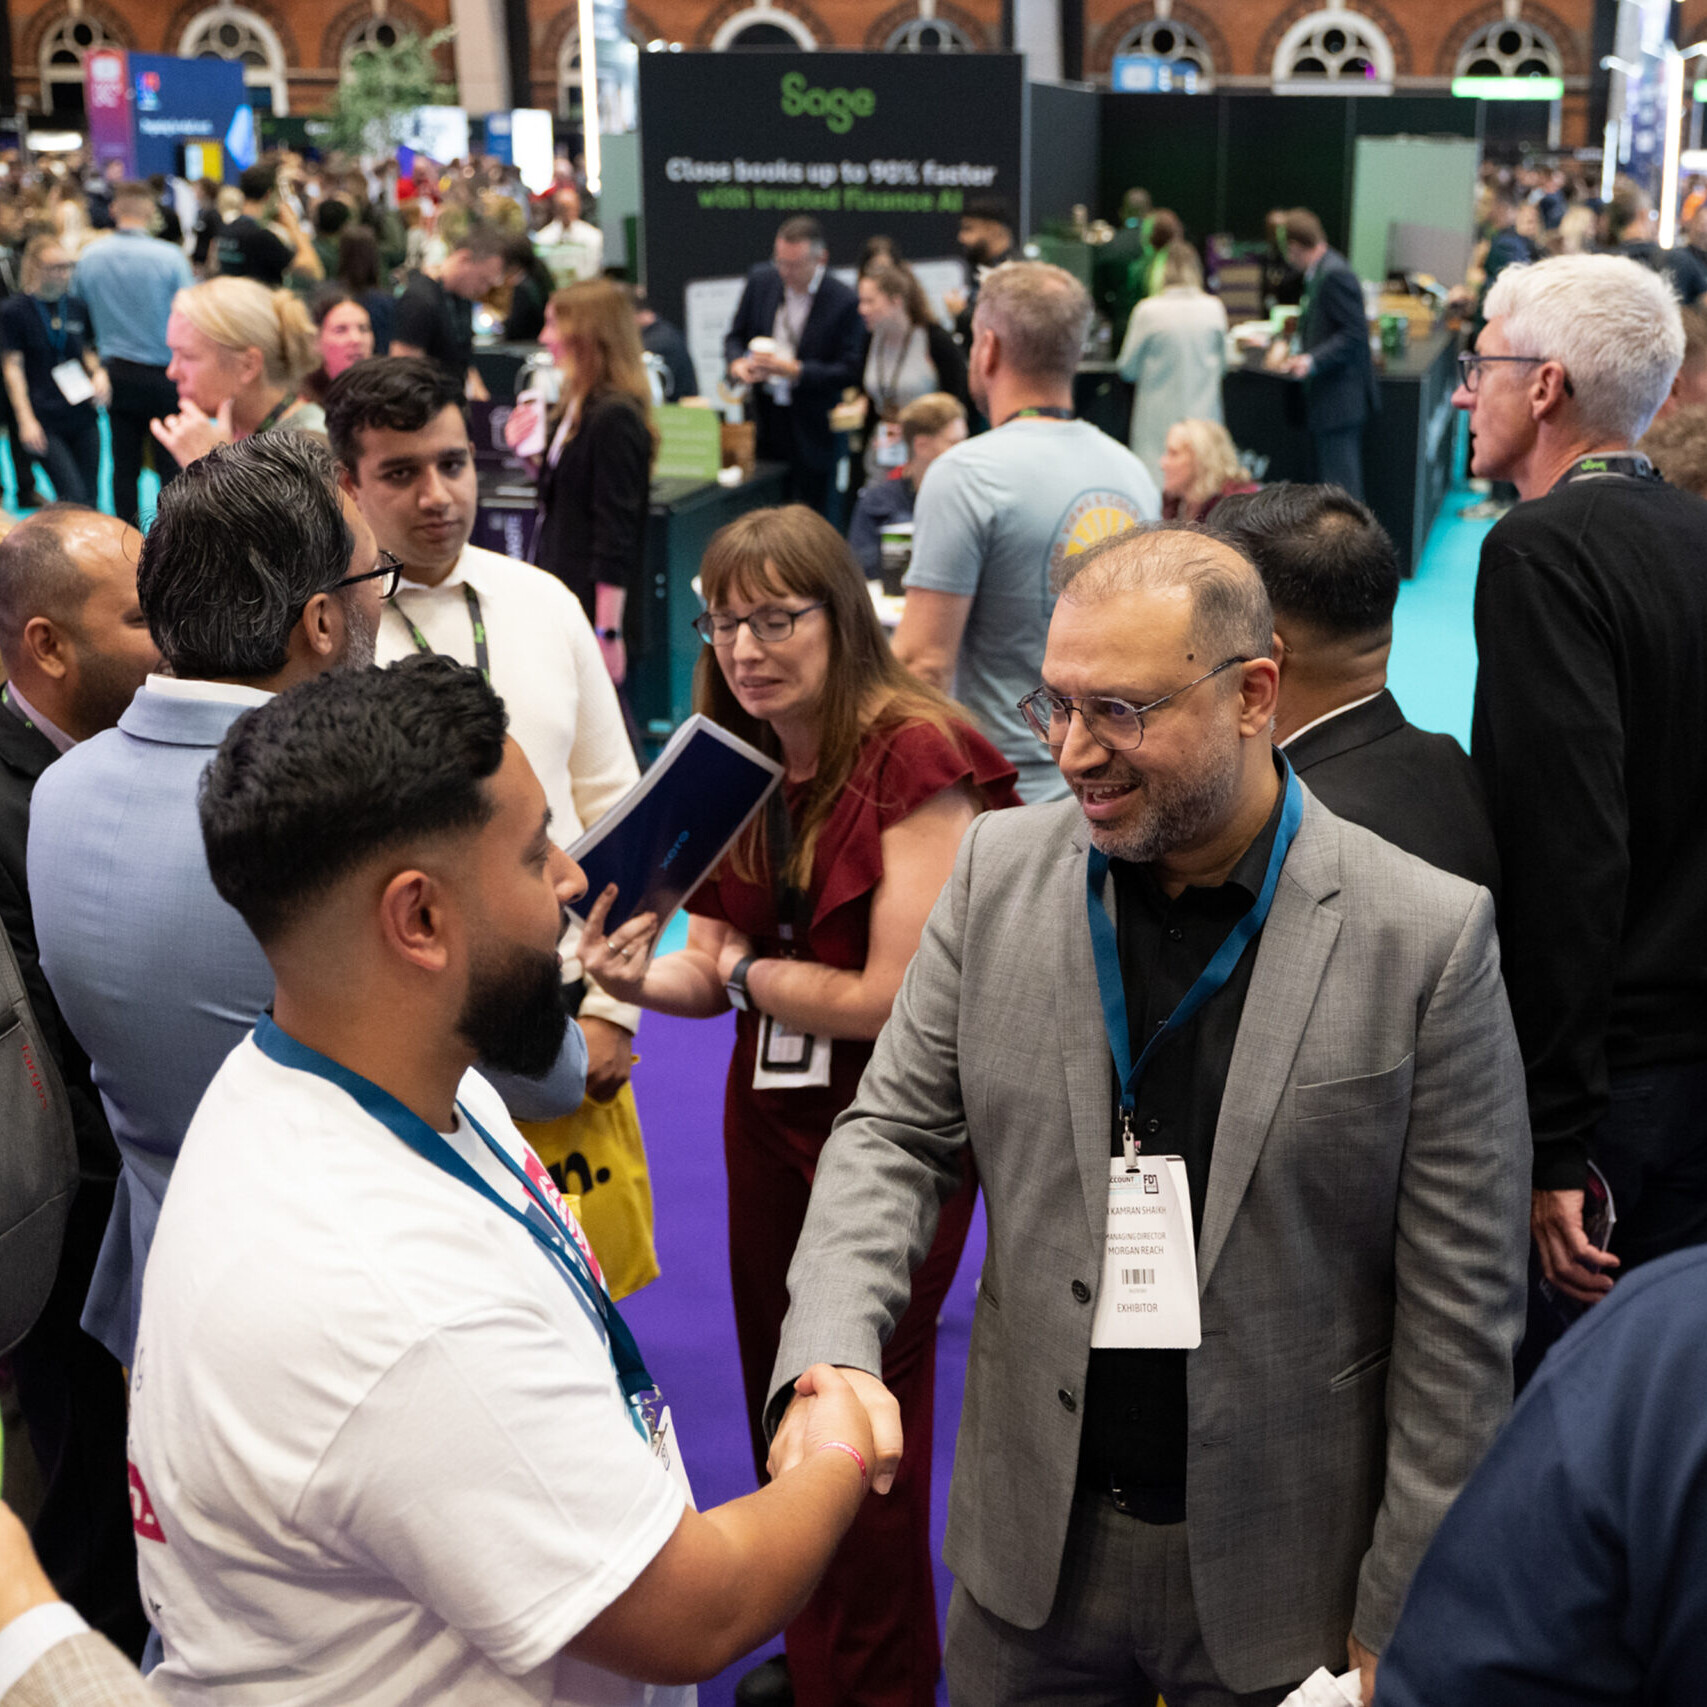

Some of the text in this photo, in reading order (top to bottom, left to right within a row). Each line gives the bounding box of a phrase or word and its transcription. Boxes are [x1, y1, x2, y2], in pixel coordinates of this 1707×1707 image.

[780, 71, 876, 134] Sage
[665, 157, 996, 187] Close books up to 90% faster
[697, 186, 963, 212] with trusted Finance AI
[659, 830, 690, 871] xero
[1110, 1206, 1166, 1215] KAMRAN SHAIKH
[1137, 1232, 1166, 1240] DIRECTOR
[1108, 1246, 1164, 1255] MORGAN REACH
[1117, 1303, 1158, 1313] EXHIBITOR
